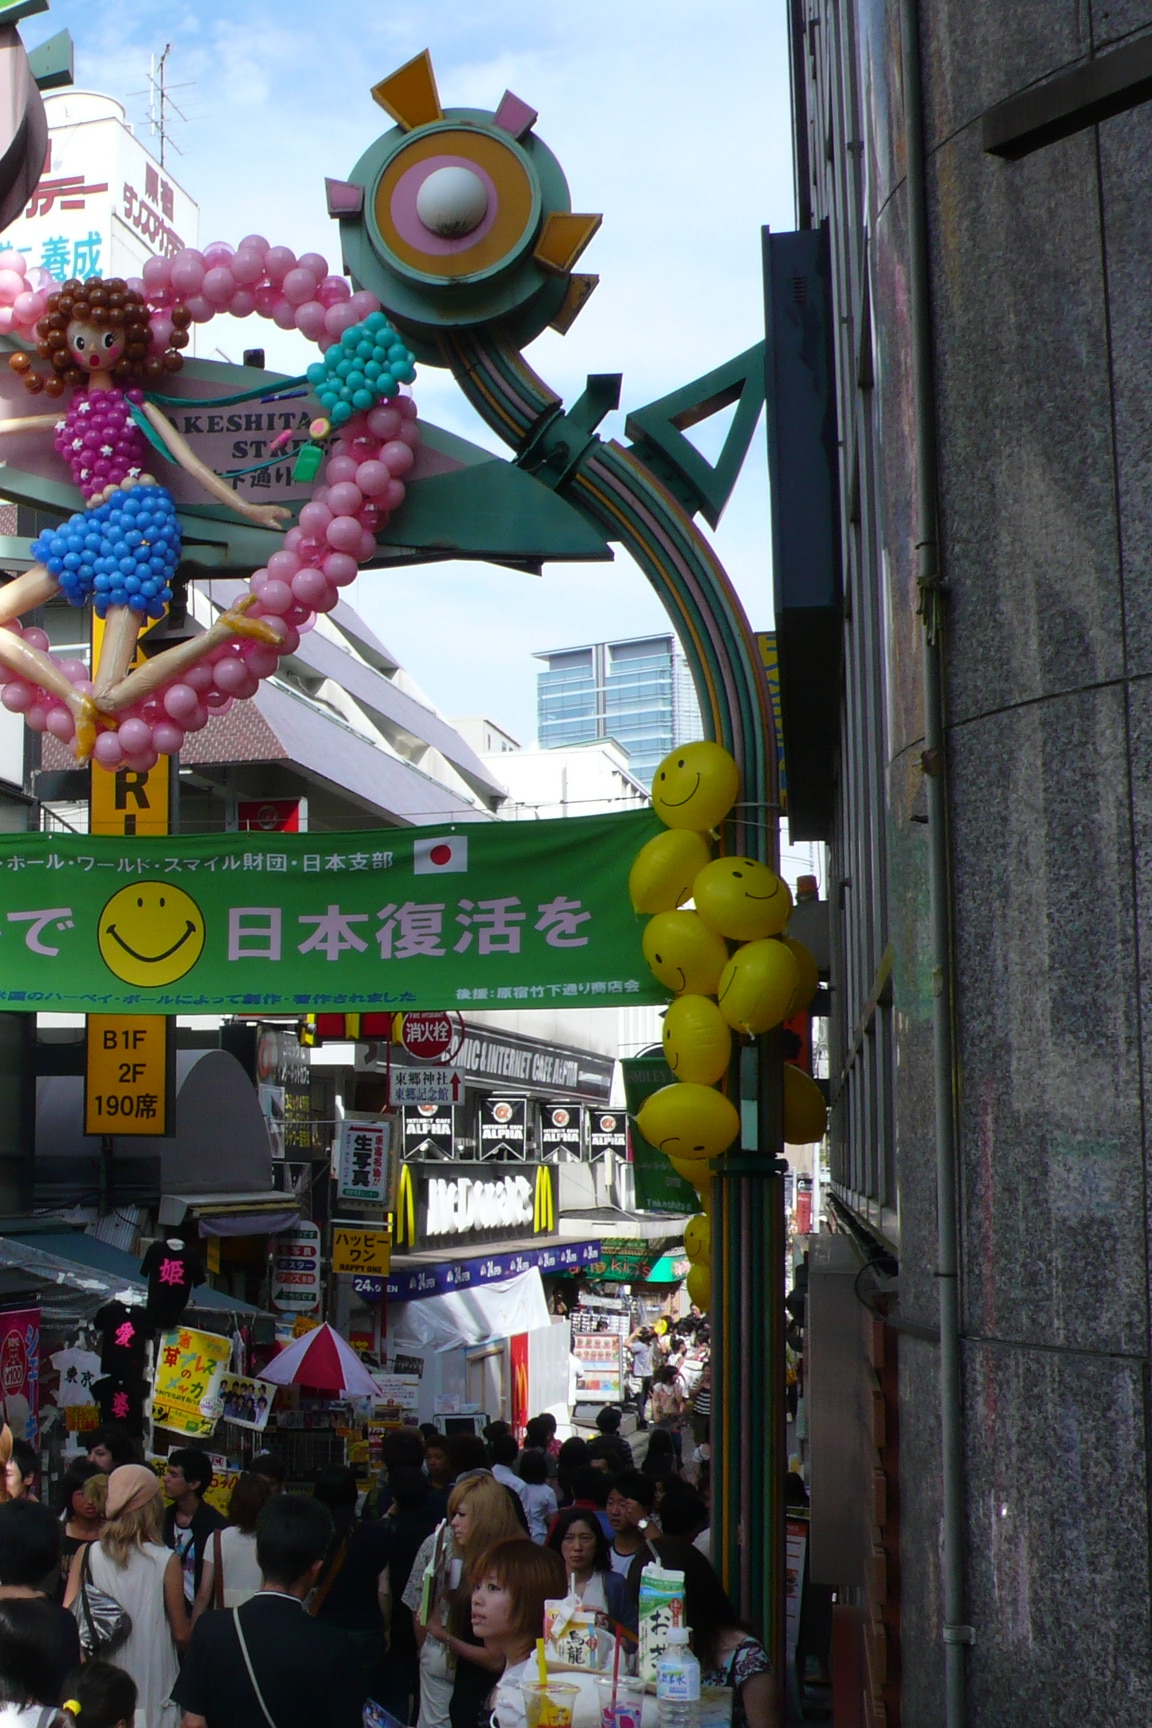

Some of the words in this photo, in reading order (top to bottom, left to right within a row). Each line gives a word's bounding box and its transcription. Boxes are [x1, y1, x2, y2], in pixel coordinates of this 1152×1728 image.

[168, 411, 313, 435] AKESHITA
[227, 896, 593, 962] 日本復活を
[103, 1029, 147, 1051] B1F
[406, 1021, 450, 1043] 消火栓
[441, 1036, 481, 1070] OMIC
[487, 1043, 533, 1080] INTERNET
[532, 1053, 553, 1083] CAFE
[118, 1063, 147, 1084] 2F
[395, 1071, 449, 1086] 東郷神社
[395, 1086, 449, 1102] 東郷記念館
[94, 1094, 157, 1119] 190席
[406, 1123, 452, 1135] ALPHA
[482, 1129, 523, 1140] ALPHA
[352, 1134, 372, 1187] 生写真
[335, 1233, 389, 1248] ハッピー
[349, 1249, 376, 1263] ワン
[158, 1257, 186, 1287] 姫
[113, 1320, 137, 1349] 愛
[65, 1364, 95, 1388] 東京
